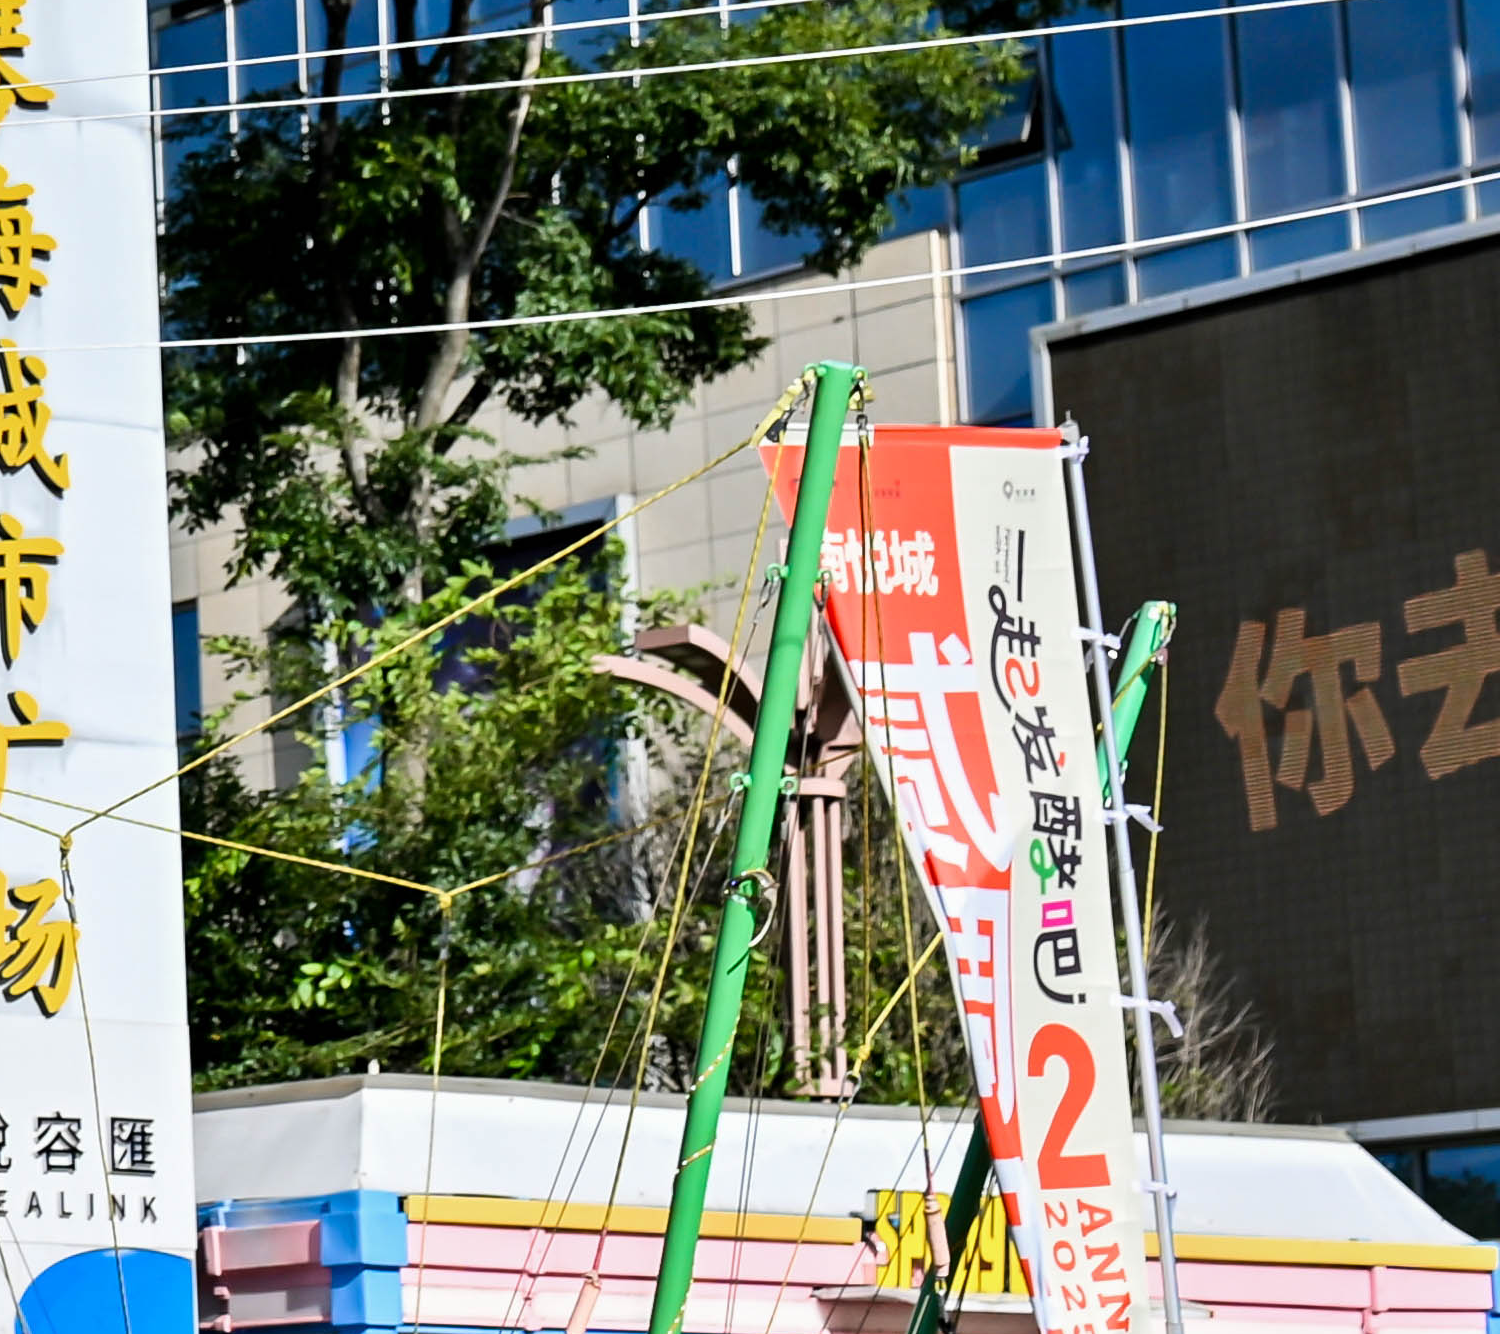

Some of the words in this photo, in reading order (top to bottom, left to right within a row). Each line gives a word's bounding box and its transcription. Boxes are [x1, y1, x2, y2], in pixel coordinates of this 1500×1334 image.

[988, 527, 1088, 1007] 一起发酵吧
[1027, 1023, 1111, 1190] 2
